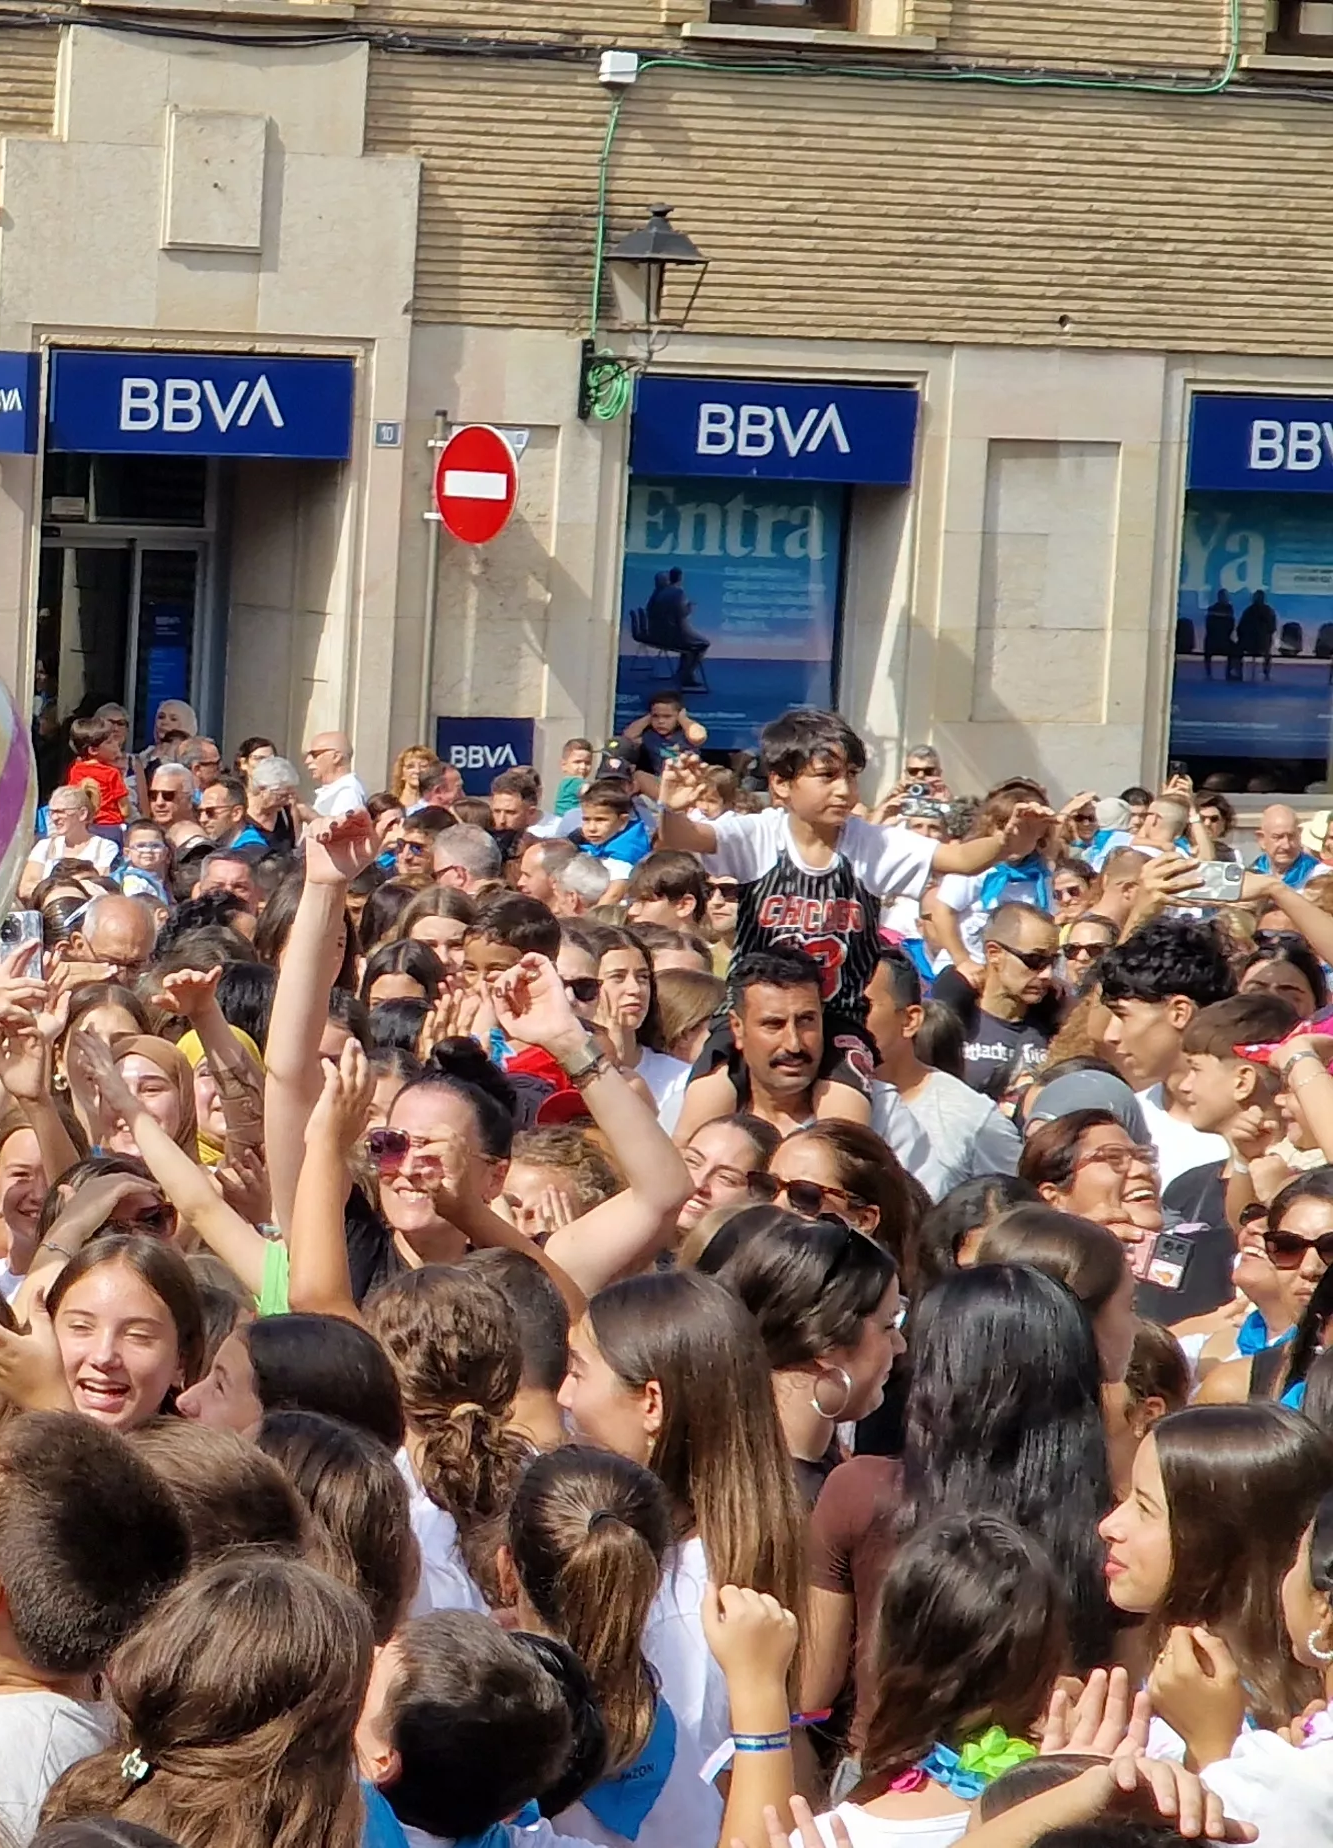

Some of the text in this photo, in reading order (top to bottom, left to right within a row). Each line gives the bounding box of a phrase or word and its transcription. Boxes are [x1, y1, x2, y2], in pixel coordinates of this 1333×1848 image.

[119, 374, 284, 433] BBVA
[695, 402, 850, 457] BBVA
[381, 425, 394, 442] 10
[1248, 419, 1333, 471] BB
[627, 484, 827, 560] Entra
[1183, 511, 1269, 594] Ya
[449, 743, 518, 769] BBVA
